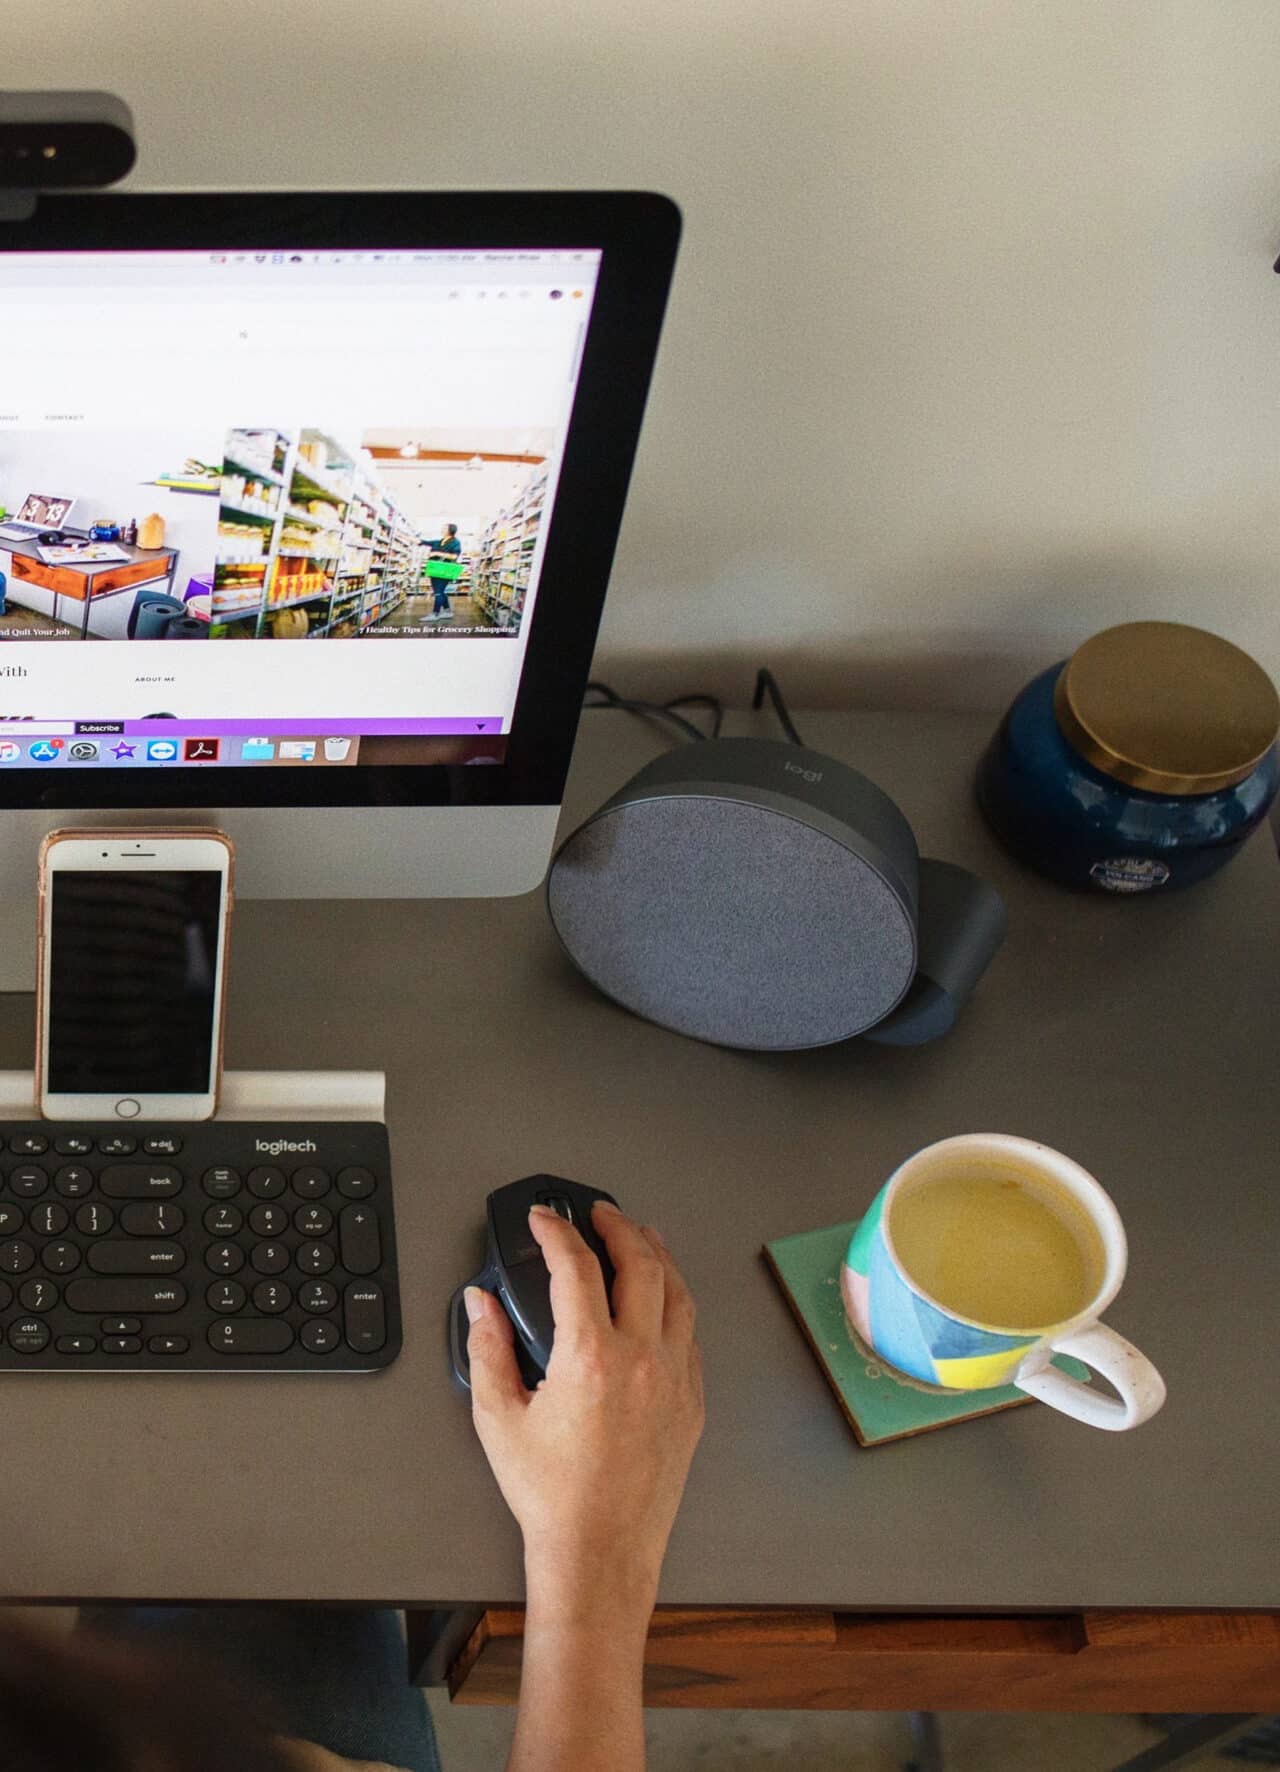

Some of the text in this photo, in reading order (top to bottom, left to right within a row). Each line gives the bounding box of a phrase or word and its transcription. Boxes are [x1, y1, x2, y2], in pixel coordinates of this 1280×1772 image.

[11, 628, 31, 636] Quit
[33, 628, 53, 636] Your
[54, 628, 70, 637] Job
[366, 626, 400, 635] Healthy
[402, 626, 421, 635] Tips
[437, 626, 472, 634] Grocery
[79, 724, 120, 732] Subscribe
[784, 760, 823, 782] logi
[255, 1139, 317, 1156] logitech
[150, 1177, 172, 1185] back
[0, 1213, 8, 1223] P
[220, 1210, 227, 1219] 7
[265, 1210, 272, 1220] 8
[310, 1210, 317, 1219] 9
[221, 1249, 229, 1257] 4
[267, 1249, 274, 1257] 5
[312, 1249, 320, 1257] 6
[154, 1291, 175, 1300] shift
[270, 1287, 276, 1296] 2
[315, 1287, 322, 1296] 3
[353, 1292, 377, 1300] enter
[21, 1323, 38, 1332] ctrl
[224, 1326, 232, 1335] 0
